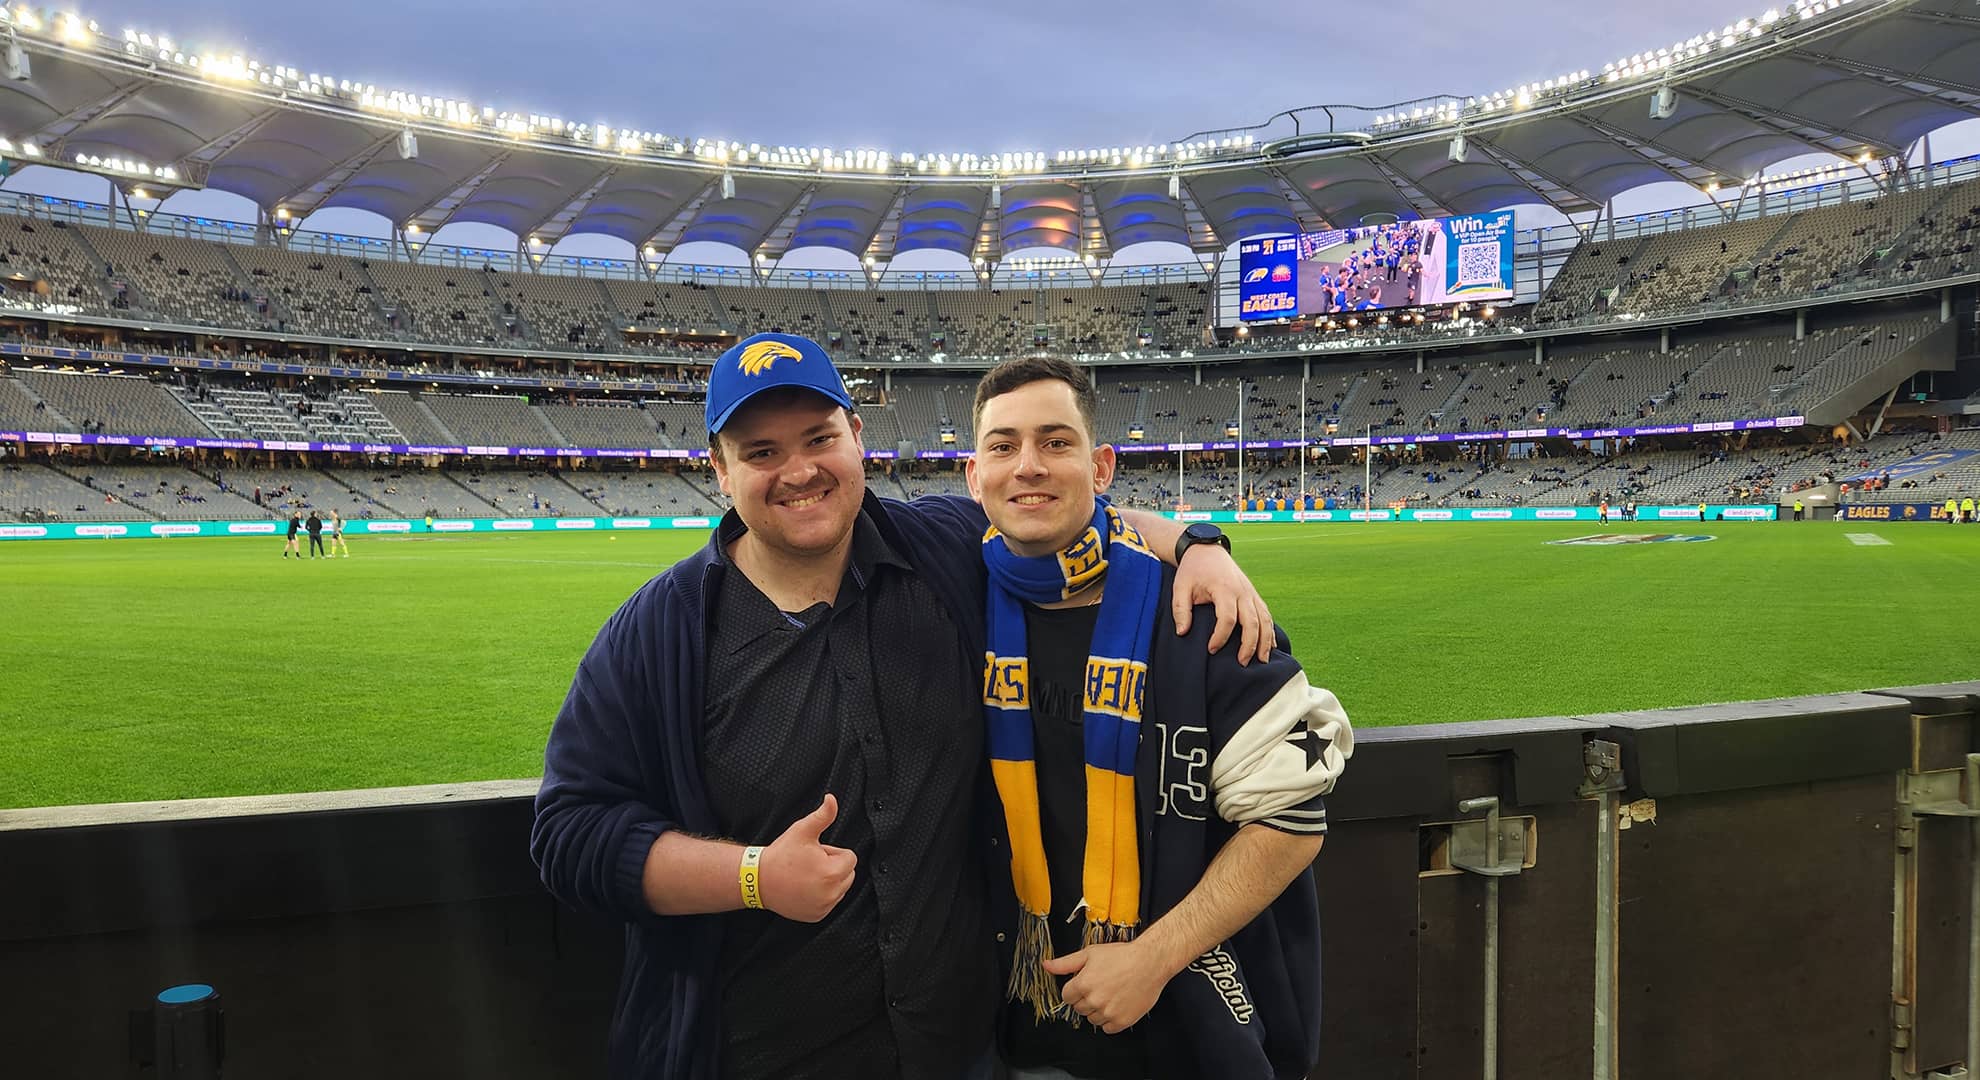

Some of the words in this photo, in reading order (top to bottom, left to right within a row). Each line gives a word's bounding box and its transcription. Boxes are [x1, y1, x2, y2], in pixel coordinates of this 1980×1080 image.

[1450, 216, 1483, 234] Win
[1263, 244, 1274, 255] 21
[1268, 292, 1288, 300] COAST
[1243, 296, 1296, 312] EAGLES
[107, 436, 130, 444] Aussie
[154, 437, 177, 446] Aussie
[1848, 506, 1890, 518] EAGLES
[745, 872, 760, 909] OPTU
[1188, 944, 1254, 1024] fficial
